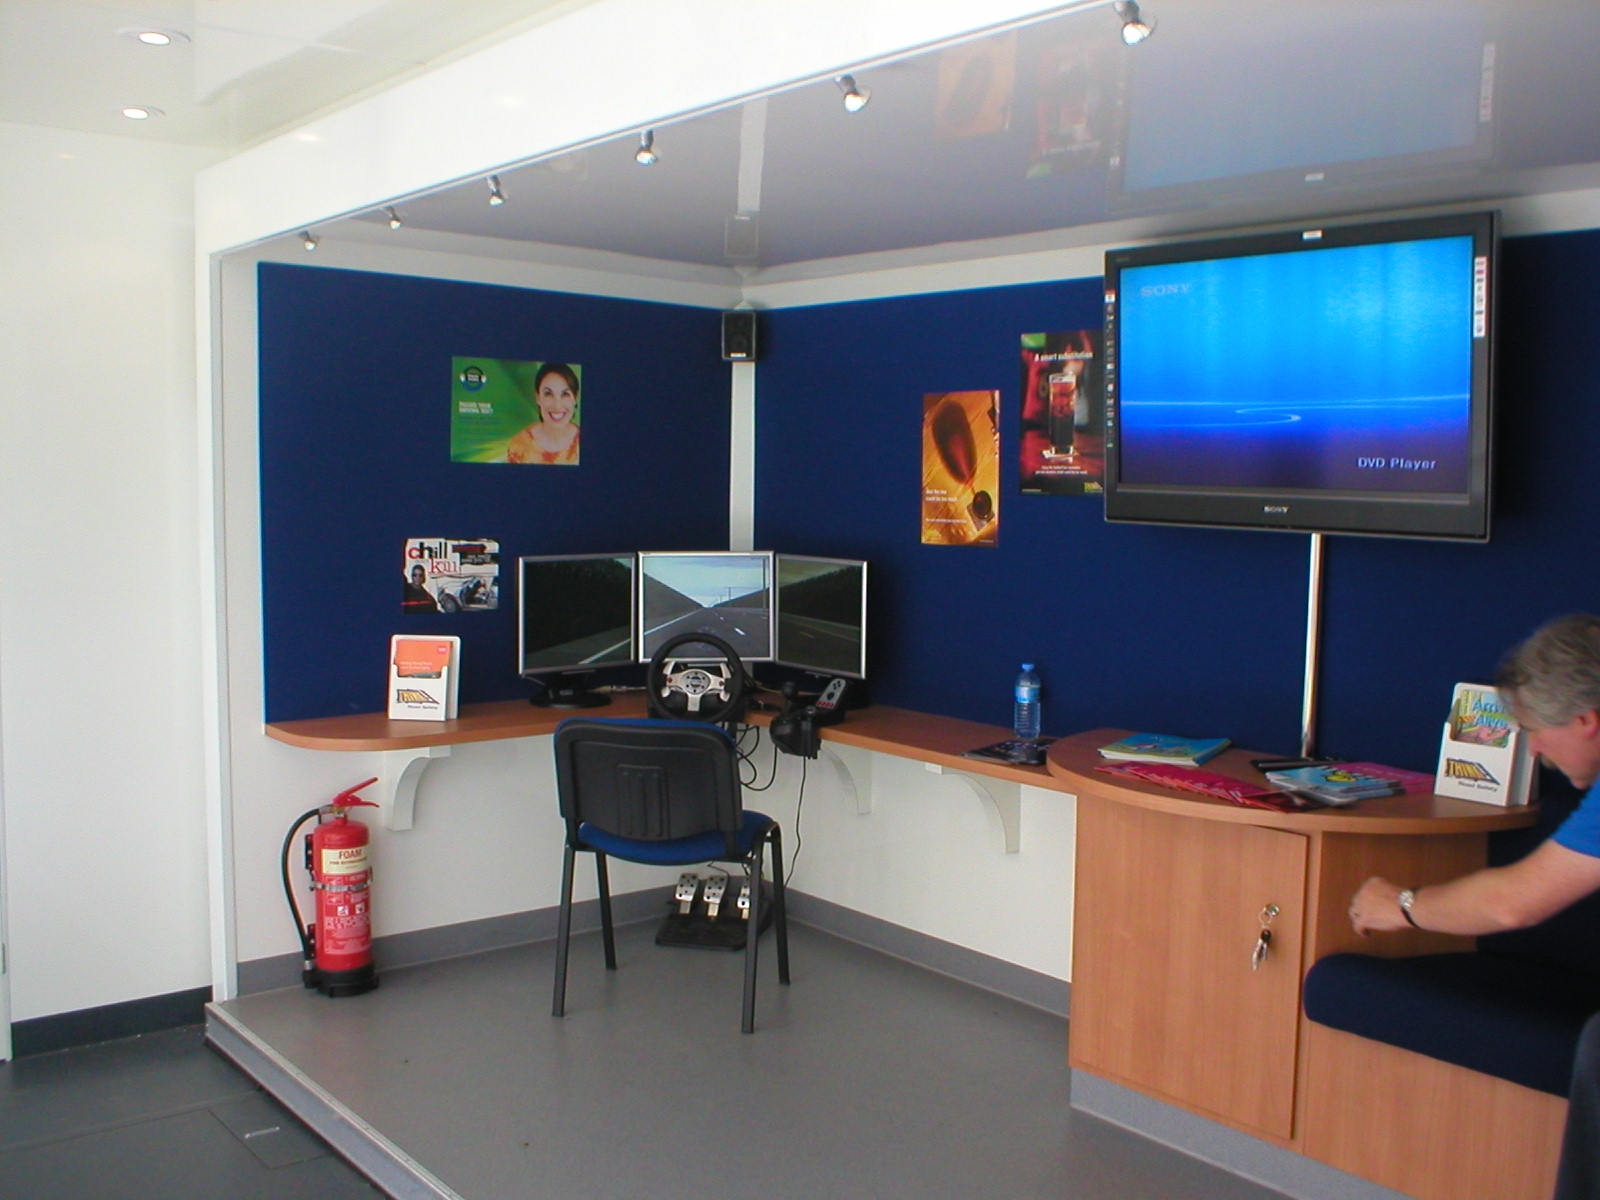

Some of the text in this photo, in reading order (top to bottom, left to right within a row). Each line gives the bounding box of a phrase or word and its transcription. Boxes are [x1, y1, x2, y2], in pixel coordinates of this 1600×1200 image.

[1140, 283, 1191, 297] SONY
[1358, 457, 1436, 471] DVD Player
[1263, 505, 1289, 514] SONY
[407, 541, 447, 559] chill
[338, 849, 362, 860] FOAM
